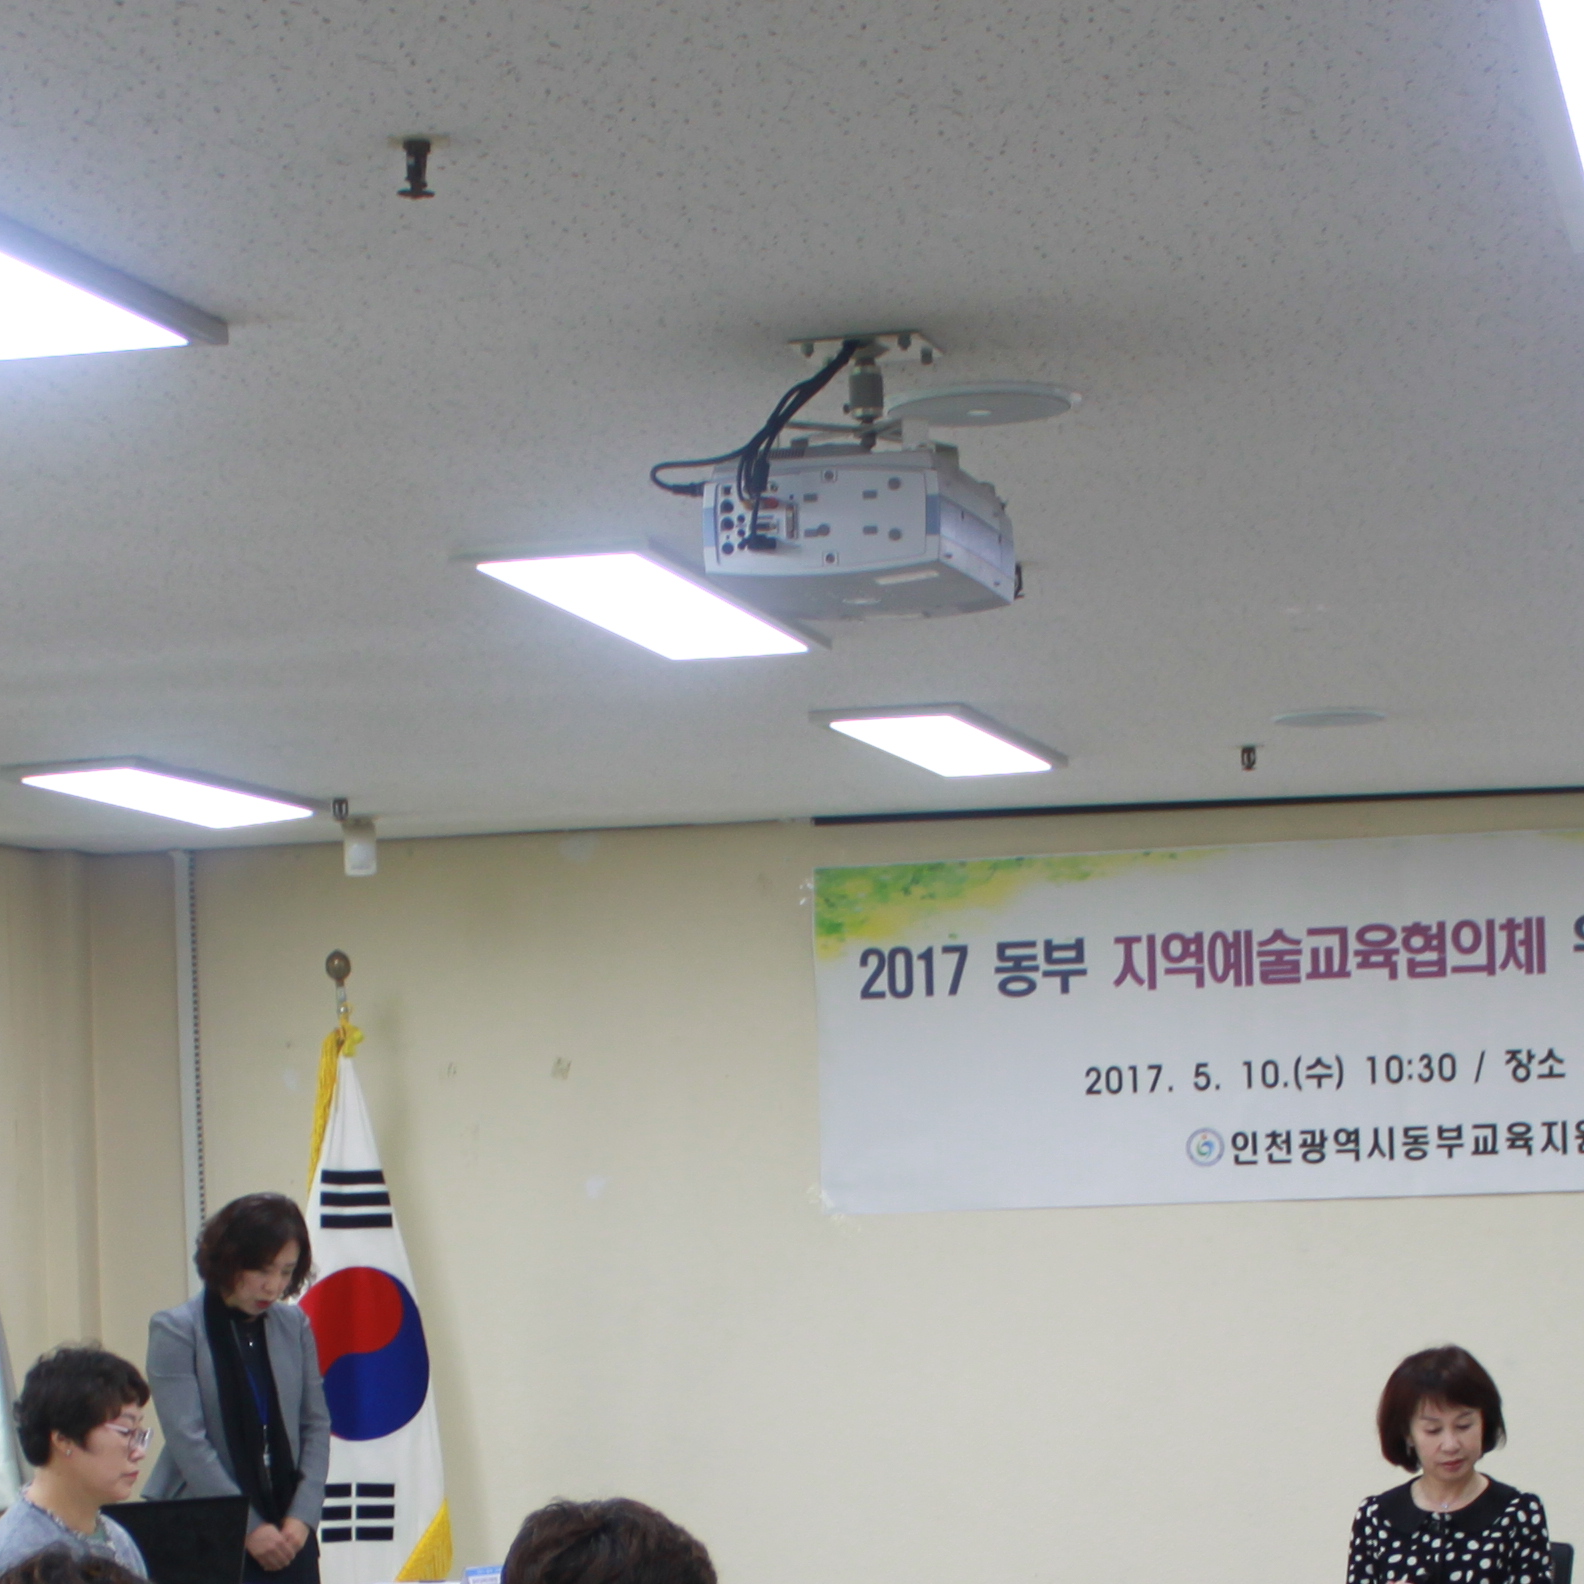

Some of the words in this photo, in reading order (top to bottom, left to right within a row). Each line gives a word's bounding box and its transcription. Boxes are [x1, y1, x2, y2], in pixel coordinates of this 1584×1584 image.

[859, 944, 969, 1000] 2017
[994, 936, 1088, 998] 동부
[1113, 915, 1547, 991] 지역예술교육협의체
[1085, 1063, 1174, 1096] 2017.
[1193, 1061, 1221, 1092] 5.
[1242, 1054, 1344, 1091] 10.(수)
[1366, 1052, 1457, 1085] 10:30
[1474, 1049, 1486, 1084] /
[1505, 1047, 1567, 1084] 장소
